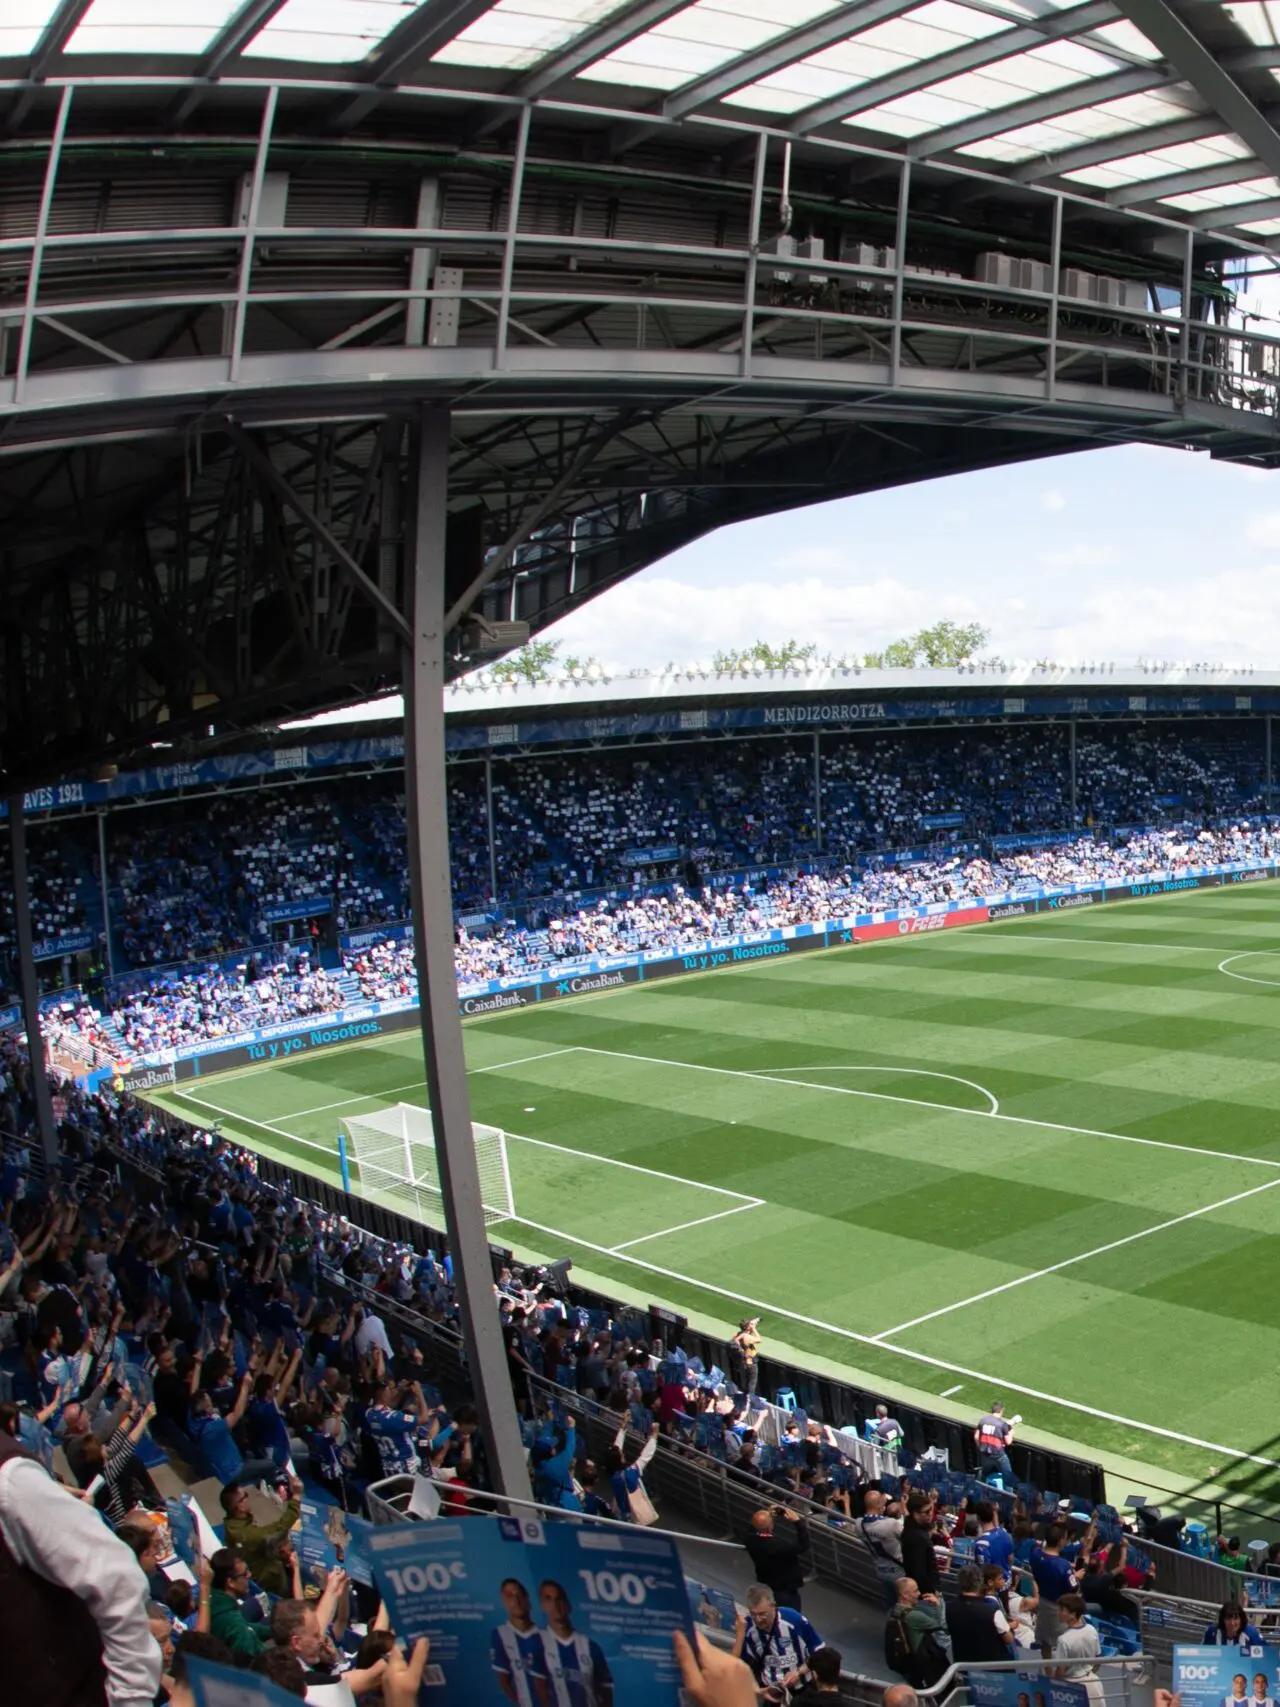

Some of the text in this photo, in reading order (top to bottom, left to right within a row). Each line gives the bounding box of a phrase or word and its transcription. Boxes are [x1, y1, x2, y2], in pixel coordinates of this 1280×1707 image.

[764, 703, 886, 723] MENDIZORROTZA
[58, 783, 84, 804] 1921
[683, 942, 789, 969] Tú y yo. Nosotros.
[571, 972, 624, 993] CaixaBank
[464, 993, 521, 1014] CaixaBank
[247, 1021, 382, 1060] Tú y yo. Nosotros.
[124, 1065, 176, 1091] aixaBank
[385, 1561, 467, 1596] 100€
[578, 1569, 658, 1605] 100€
[1179, 1664, 1219, 1680] 100€
